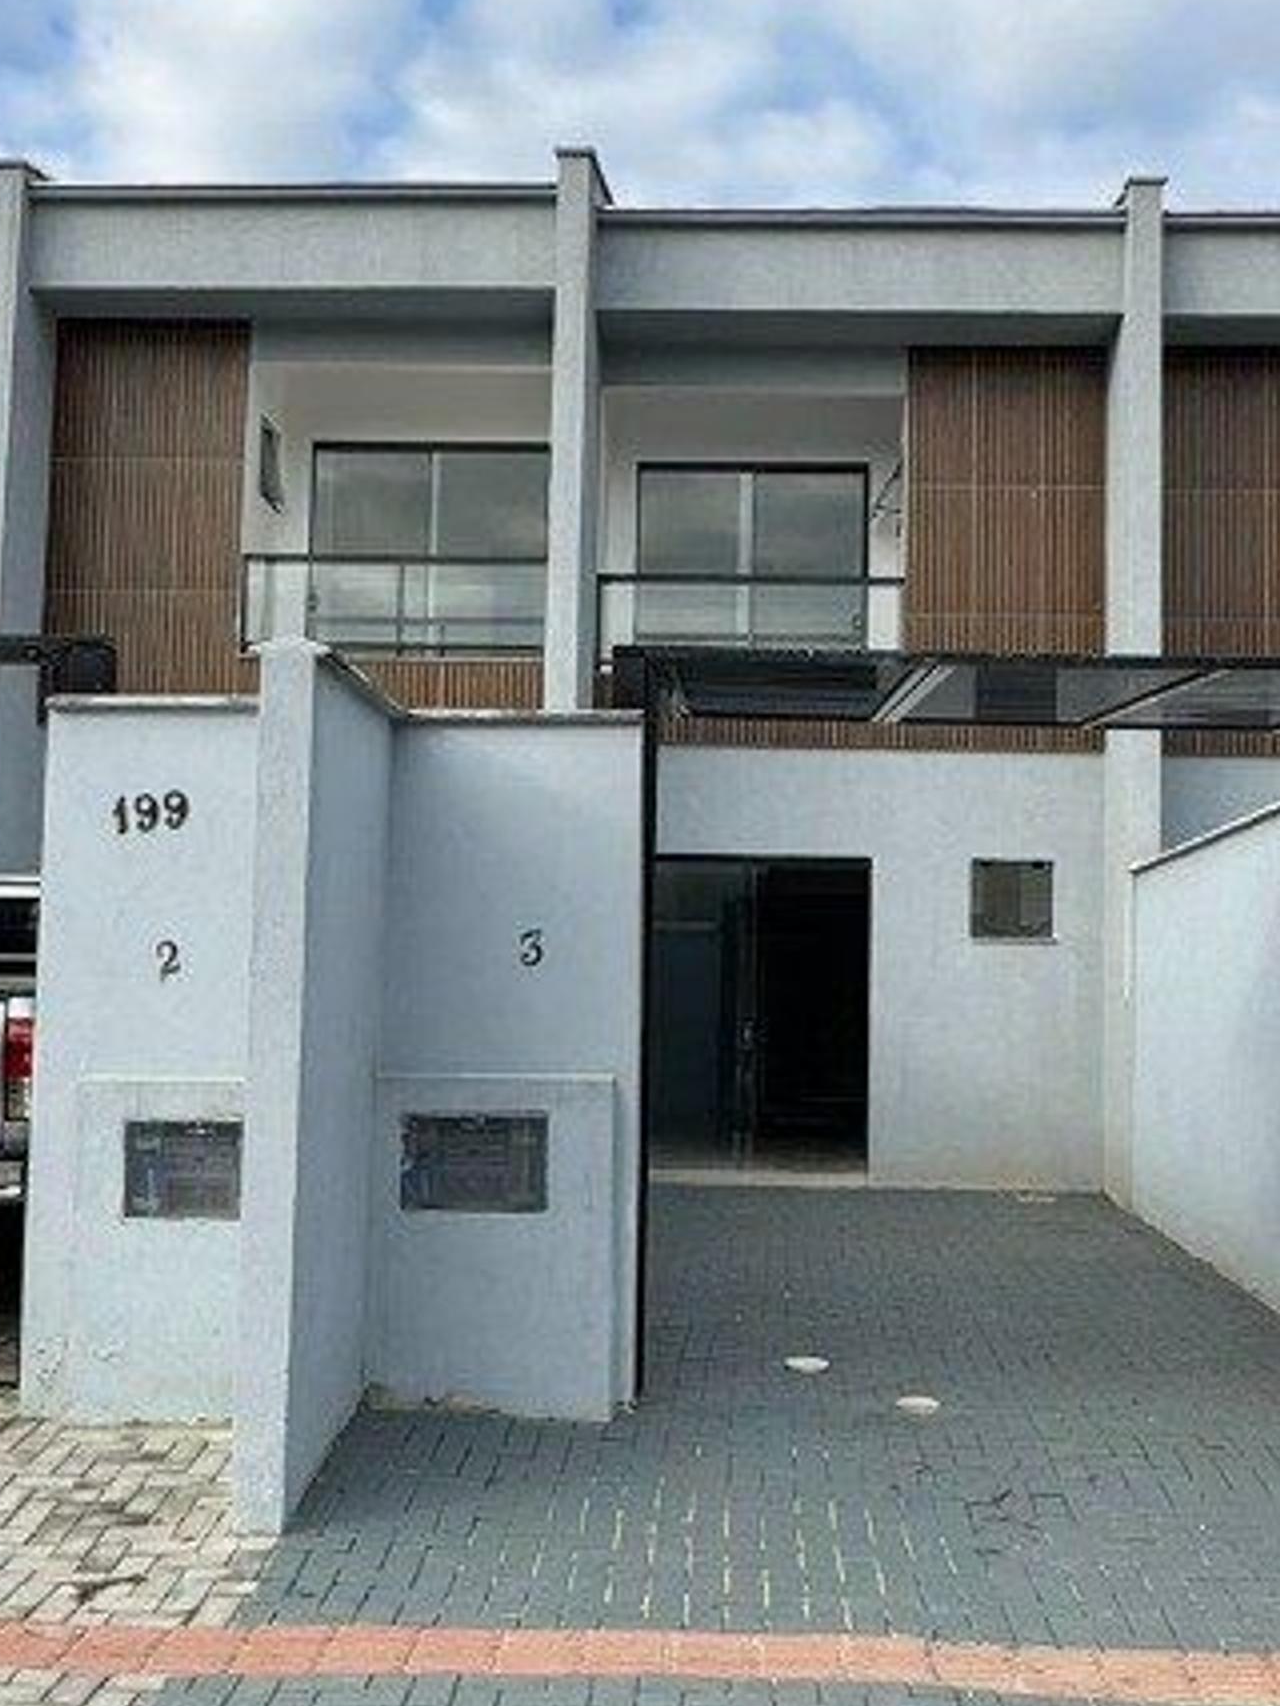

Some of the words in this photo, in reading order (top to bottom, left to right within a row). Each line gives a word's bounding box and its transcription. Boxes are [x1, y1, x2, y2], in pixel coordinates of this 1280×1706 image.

[112, 789, 190, 835] 199
[156, 940, 181, 983] 2
[520, 928, 543, 967] 3
